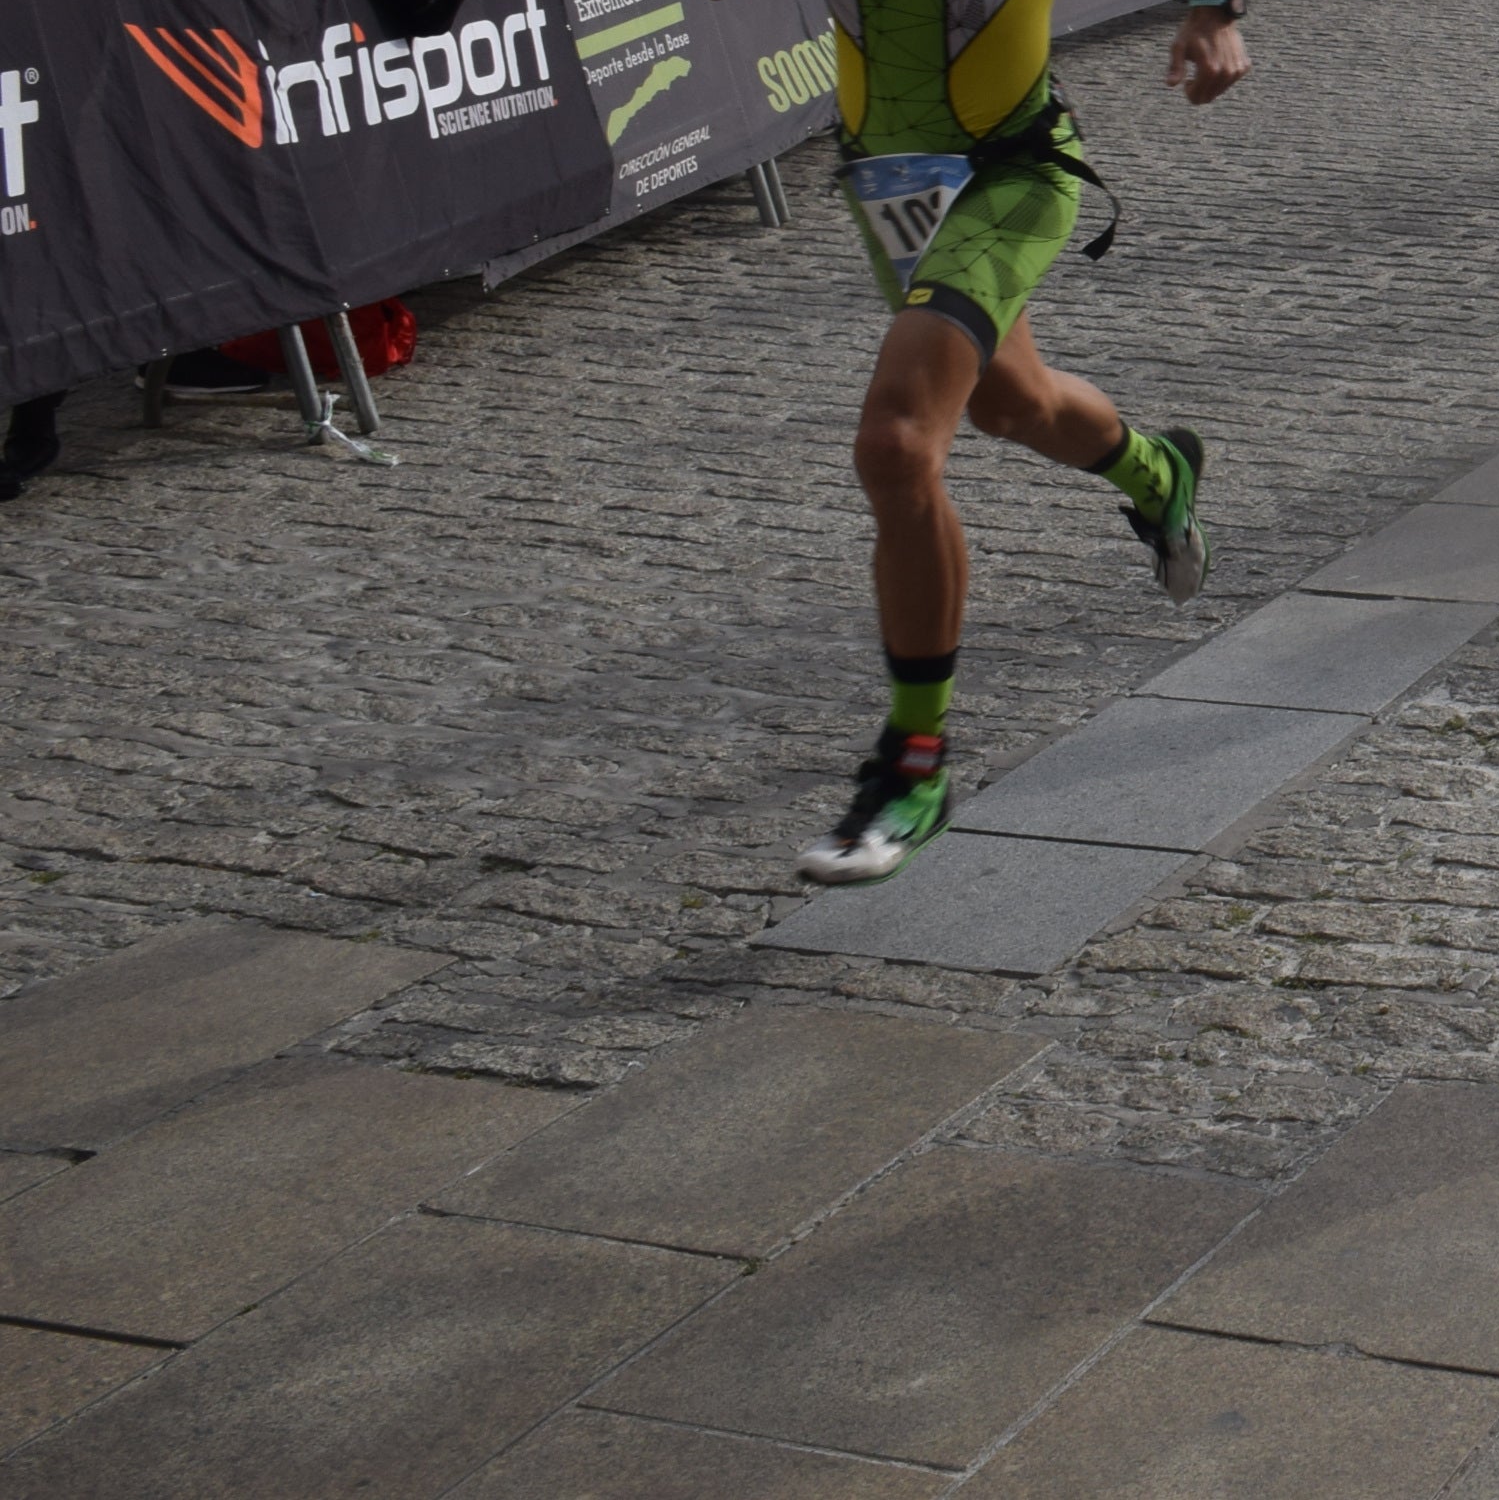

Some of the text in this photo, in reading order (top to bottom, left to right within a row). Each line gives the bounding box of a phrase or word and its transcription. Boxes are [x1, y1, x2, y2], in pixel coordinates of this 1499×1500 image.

[625, 48, 655, 70] desde
[666, 31, 690, 57] Base
[438, 100, 491, 137] SCIENCE
[618, 124, 712, 180] DIRECCIÓN GENERAL
[636, 155, 698, 197] DE DEPORTES
